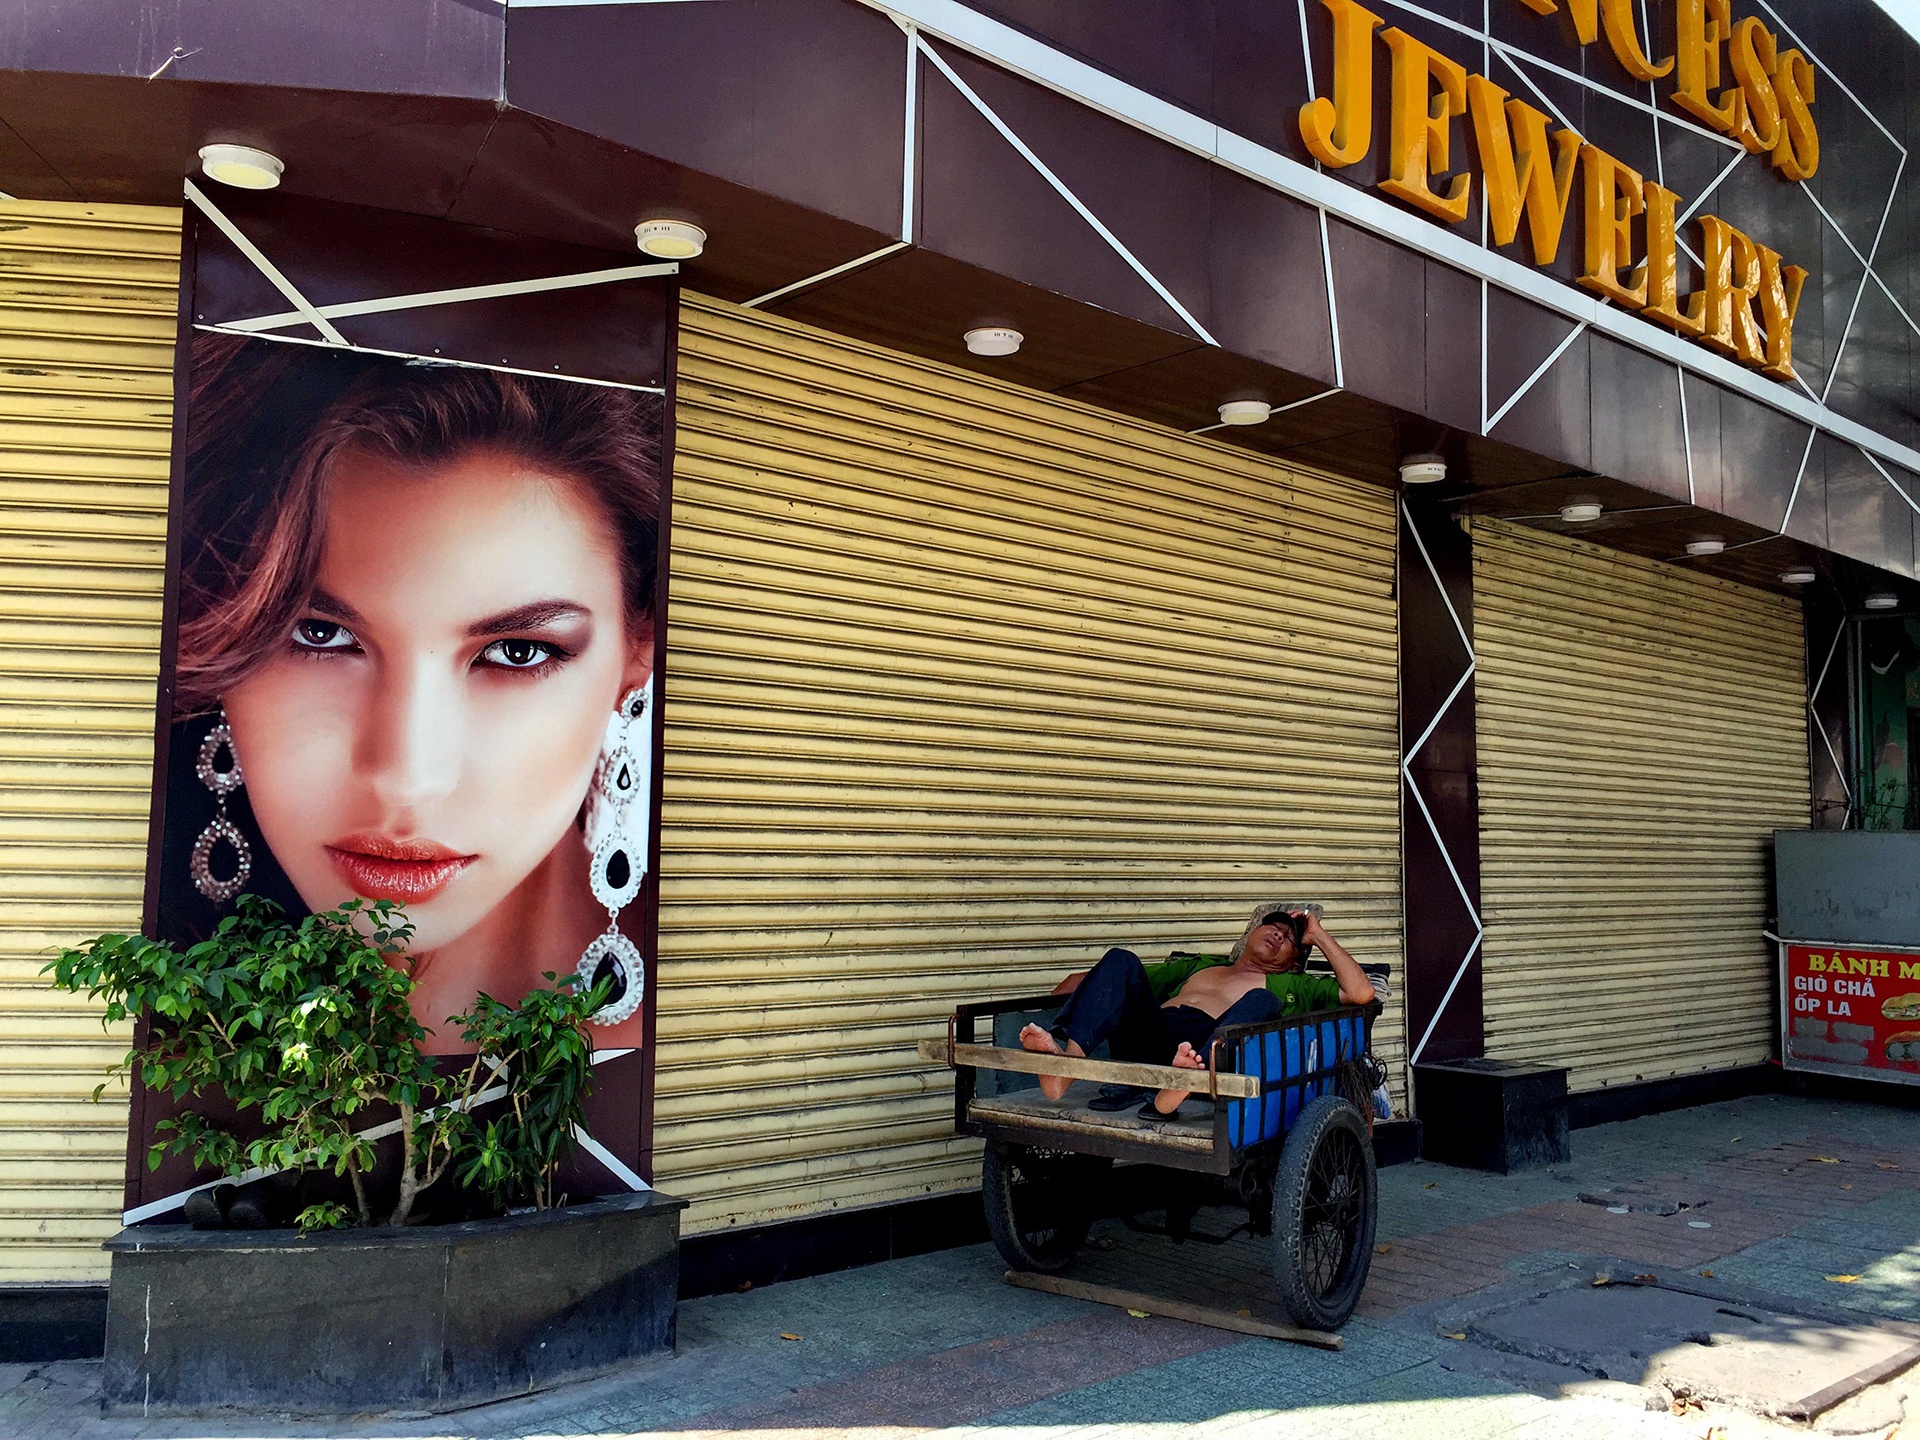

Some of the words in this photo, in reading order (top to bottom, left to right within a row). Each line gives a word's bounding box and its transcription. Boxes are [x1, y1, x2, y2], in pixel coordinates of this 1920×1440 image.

[1299, 0, 1809, 381] JEWELRY
[1808, 951, 1890, 978] BÁNH
[1794, 974, 1828, 993] GIÒ
[1833, 977, 1876, 998] CHẢ
[1794, 992, 1821, 1013] ỐP
[1827, 1000, 1852, 1017] LA
